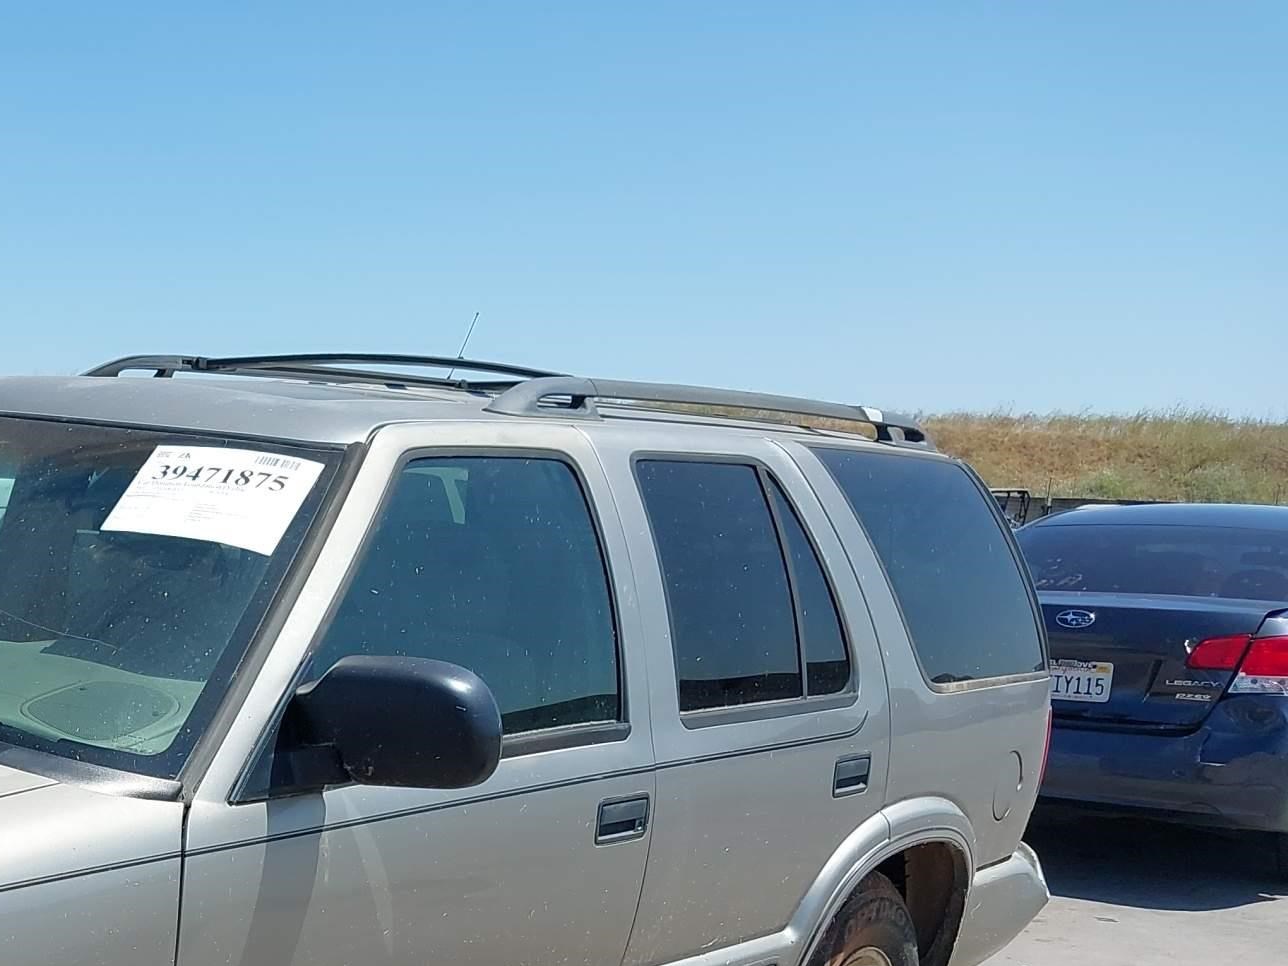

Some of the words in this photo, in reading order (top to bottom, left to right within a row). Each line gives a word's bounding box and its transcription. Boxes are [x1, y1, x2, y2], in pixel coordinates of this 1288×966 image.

[151, 464, 289, 492] 39471875
[1050, 673, 1105, 697] IY115
[1165, 679, 1220, 688] LEGACY
